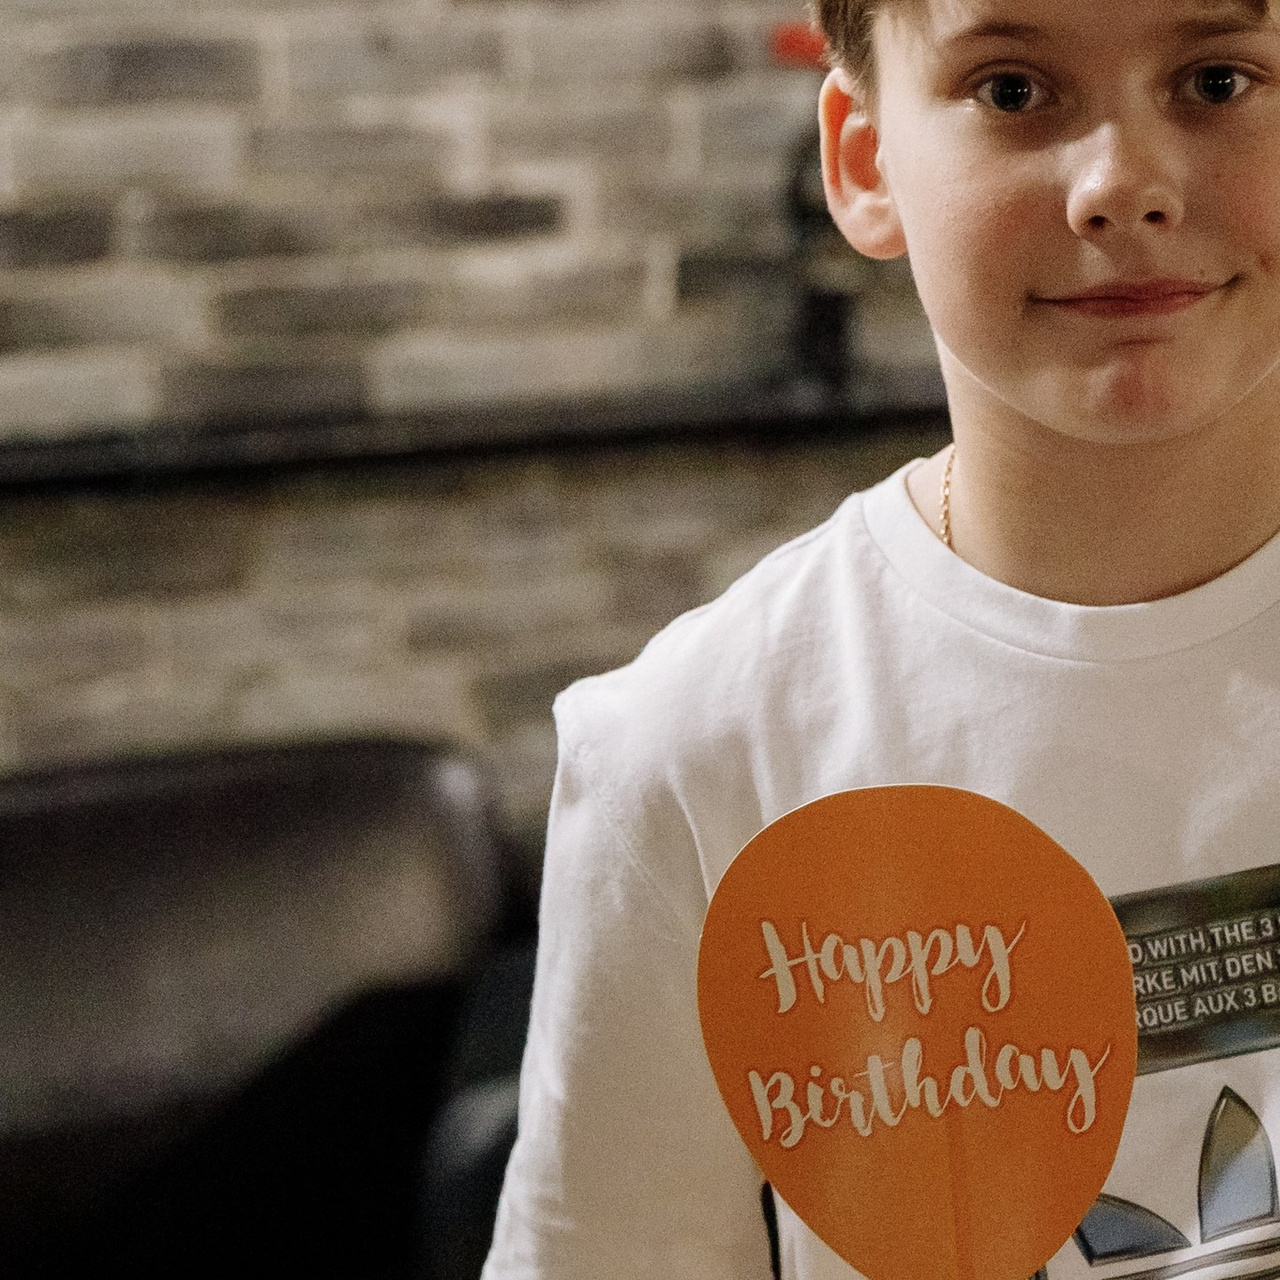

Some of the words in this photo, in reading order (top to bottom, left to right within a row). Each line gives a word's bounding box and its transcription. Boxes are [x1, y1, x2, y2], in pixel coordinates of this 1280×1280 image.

[1209, 920, 1255, 949] THE
[1260, 917, 1274, 938] 3
[758, 920, 1027, 1021] Happy
[1225, 950, 1273, 979] DEN
[1193, 990, 1241, 1018] AUX
[1244, 987, 1258, 1008] 3
[749, 1026, 1111, 1148] Birthday
